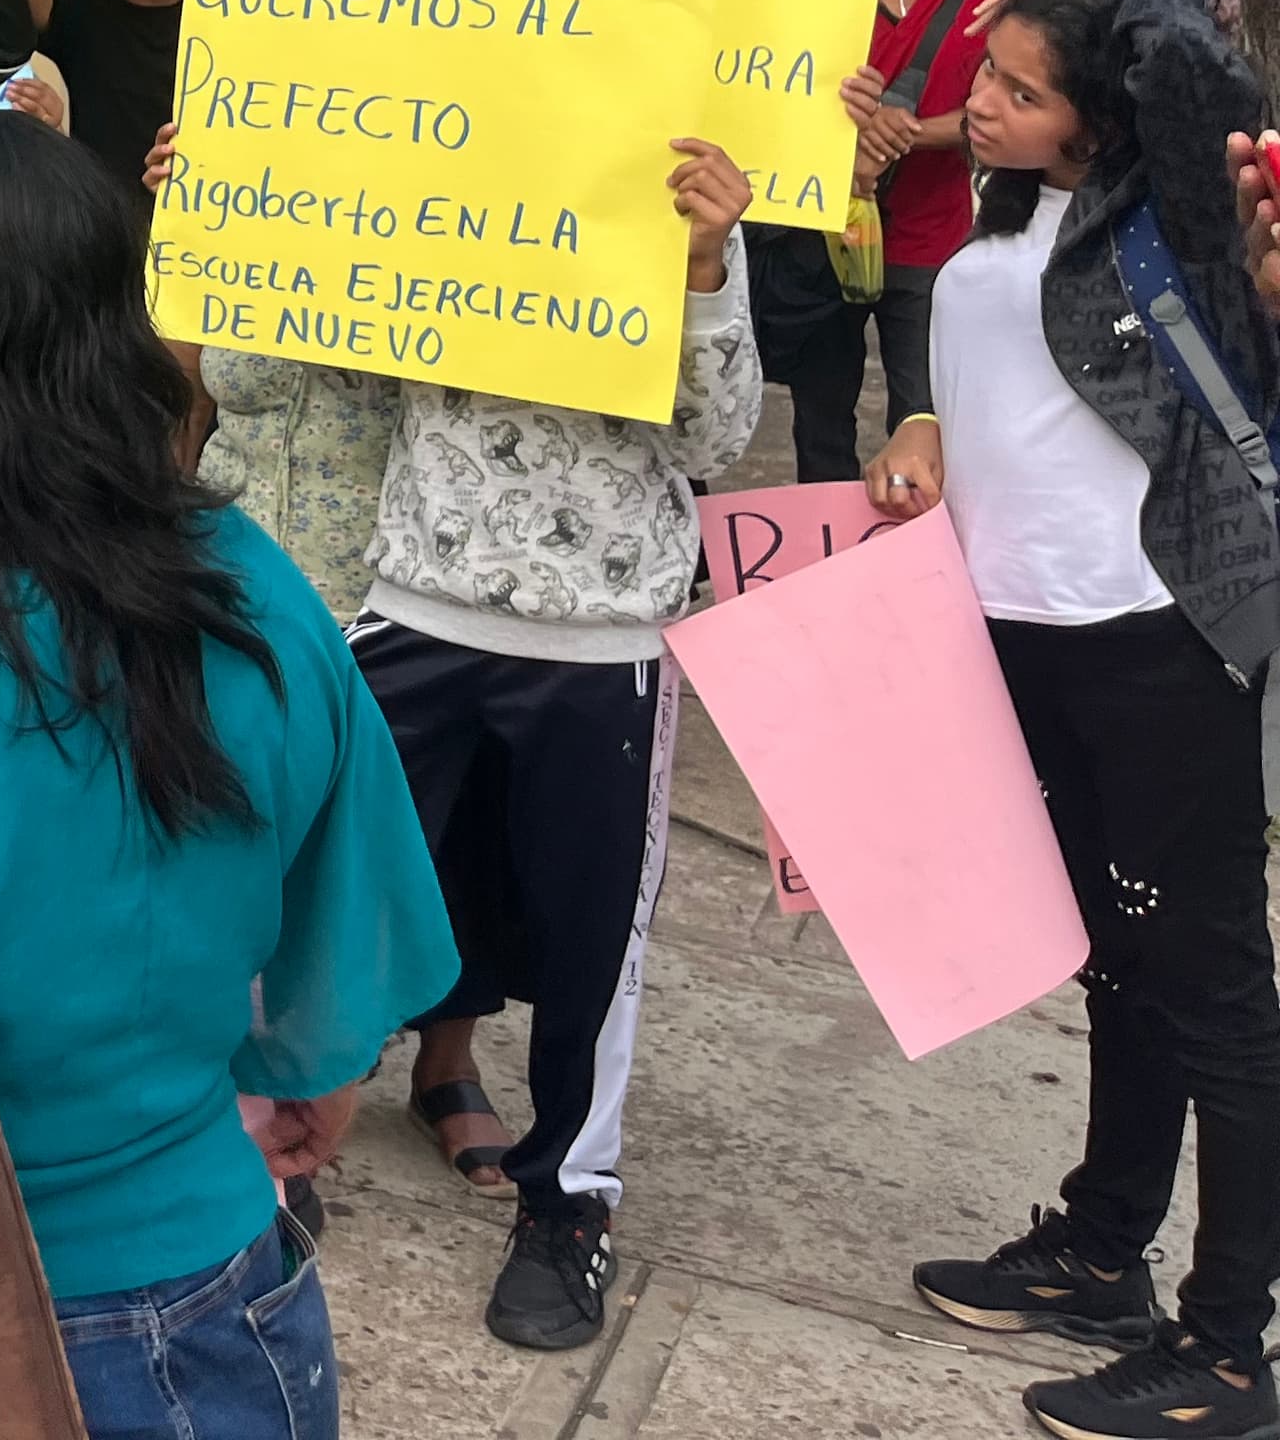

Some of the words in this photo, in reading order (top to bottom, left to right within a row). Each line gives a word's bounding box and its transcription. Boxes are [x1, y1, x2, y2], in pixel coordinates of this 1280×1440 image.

[176, 36, 471, 150] PREFECTO
[160, 150, 398, 240] Rigoberto
[416, 195, 487, 241] EN
[508, 203, 579, 254] LA
[152, 240, 318, 297] ESCUELA
[346, 262, 650, 347] EJERCIENDO
[202, 294, 256, 341] DE
[275, 306, 444, 366] NUEVO
[725, 512, 906, 597] RI
